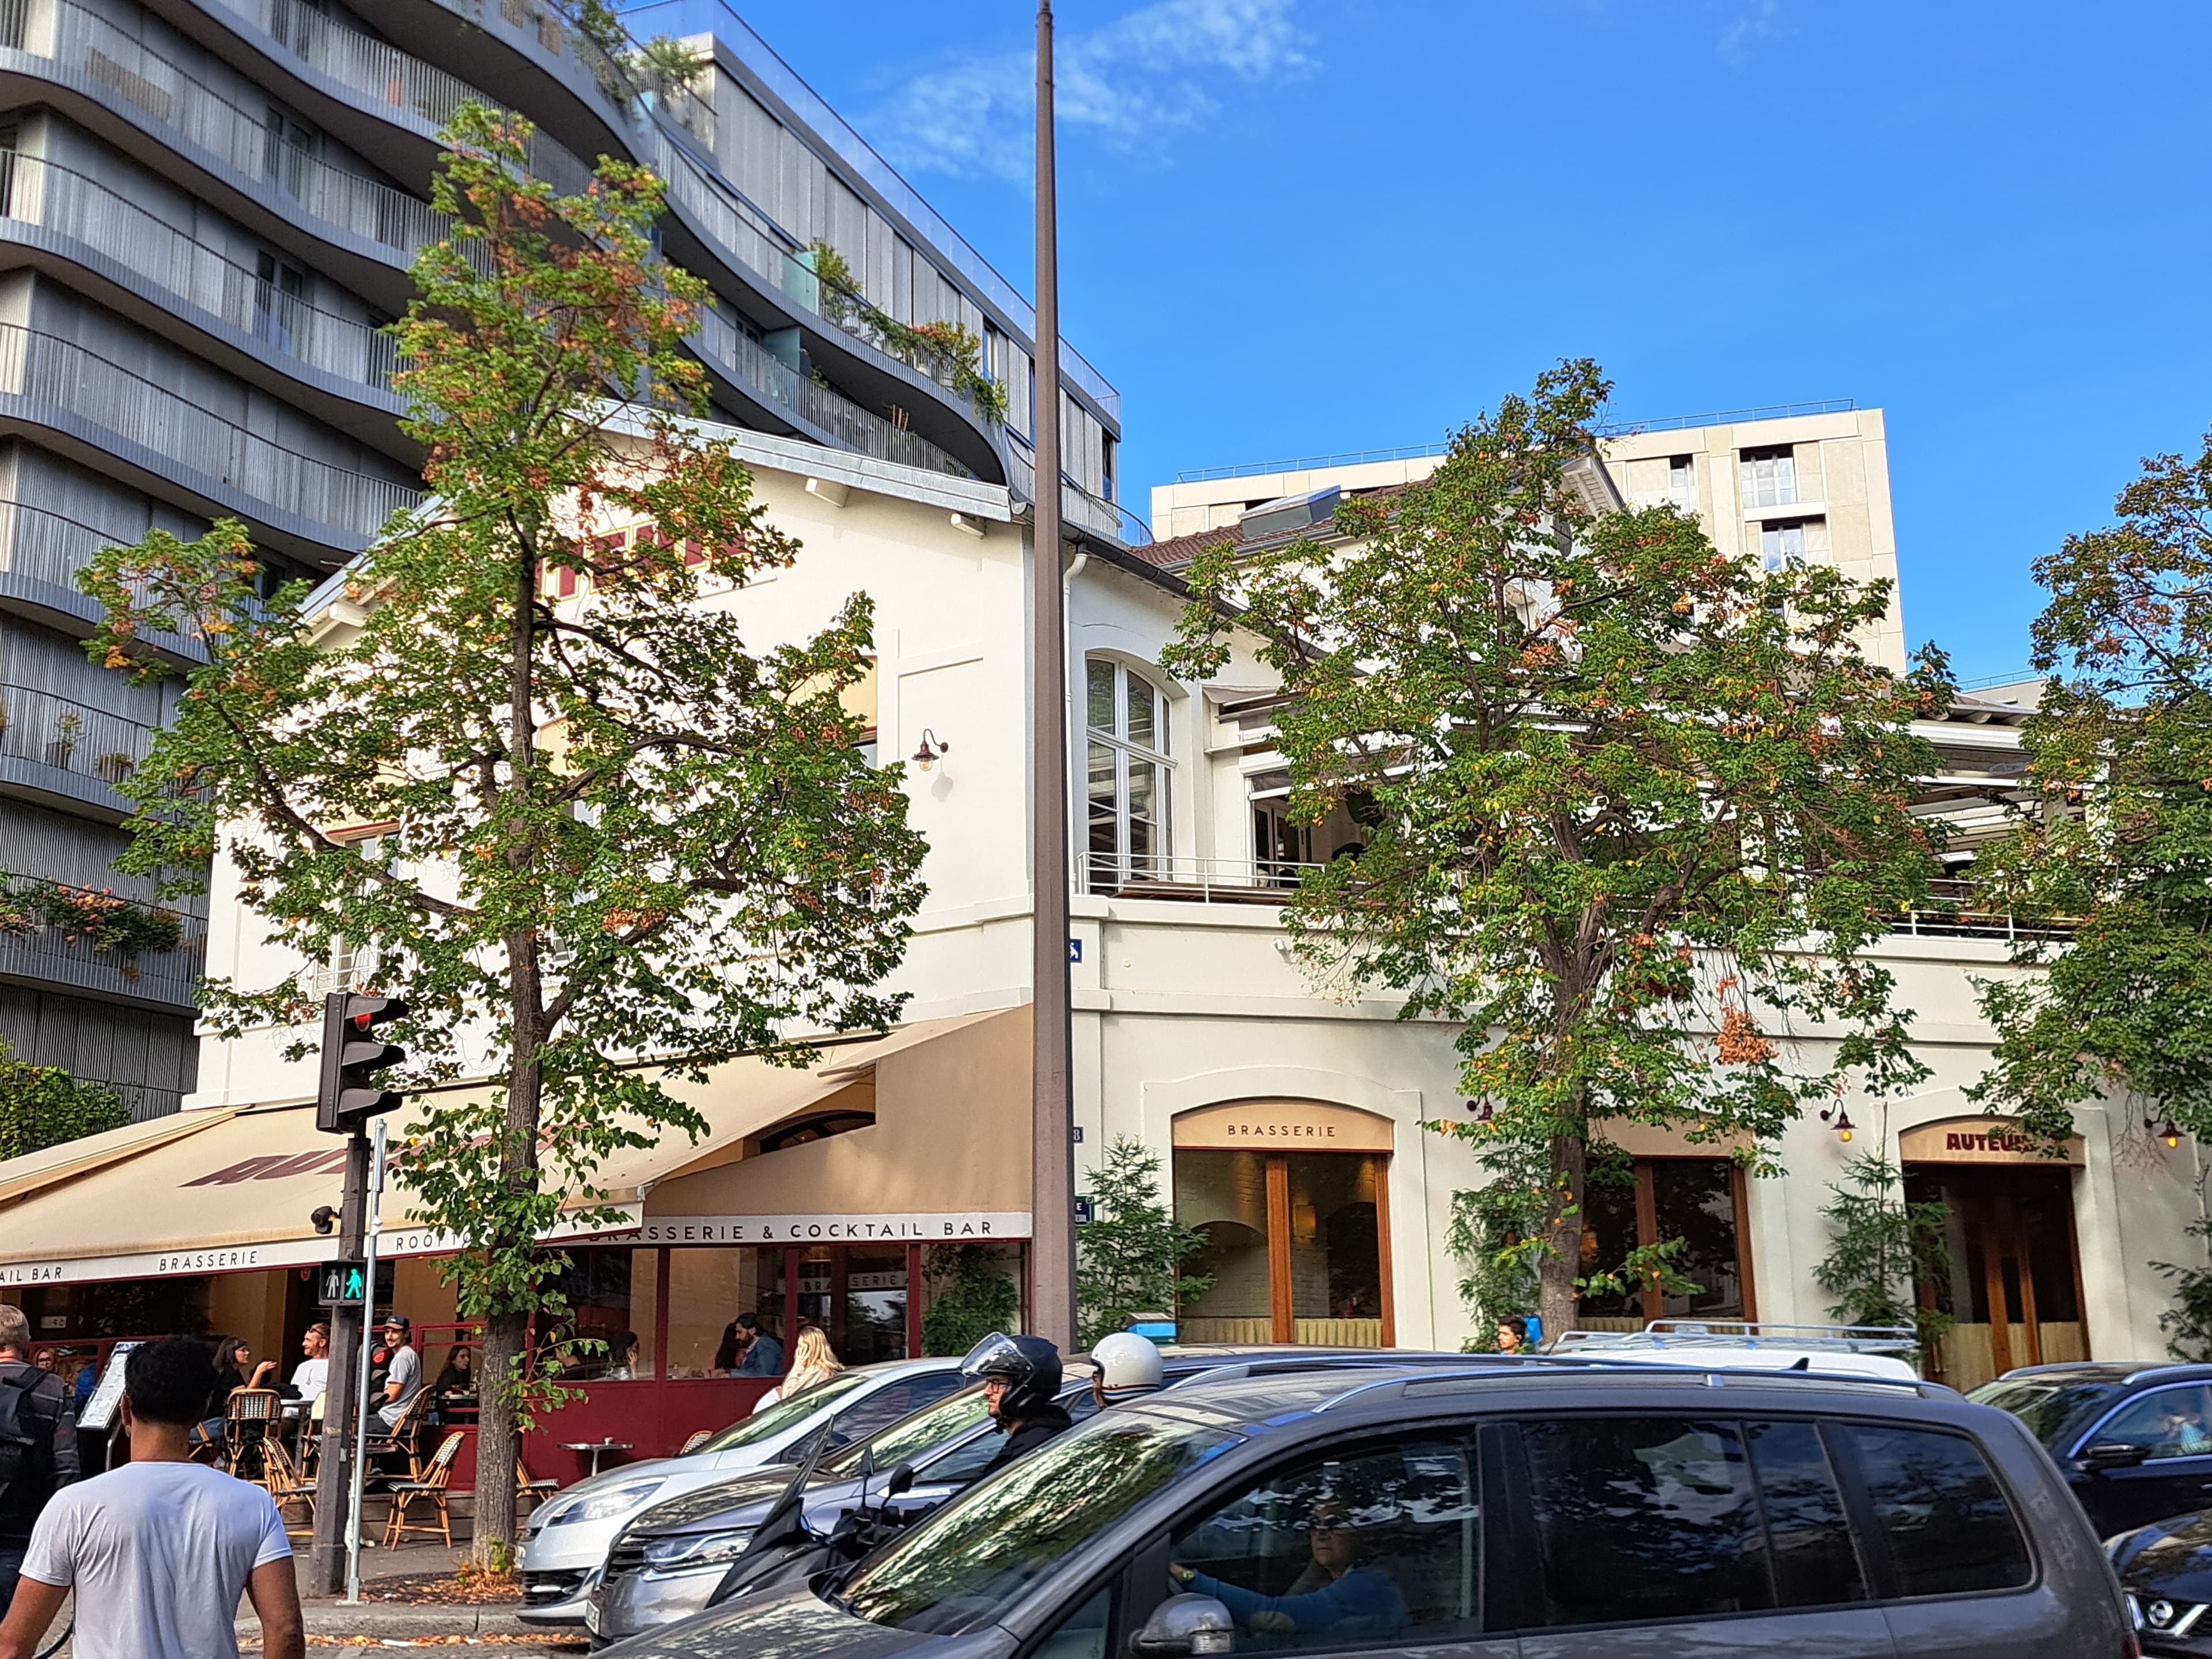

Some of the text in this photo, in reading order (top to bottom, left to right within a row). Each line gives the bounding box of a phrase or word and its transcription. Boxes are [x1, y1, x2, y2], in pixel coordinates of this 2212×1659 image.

[1228, 1124, 1336, 1137] BRASSERIE
[589, 1222, 992, 1241] ASSERIE & COCKTAIL BAR
[159, 1251, 258, 1271] BRASSERIE
[32, 1266, 62, 1281] BAR
